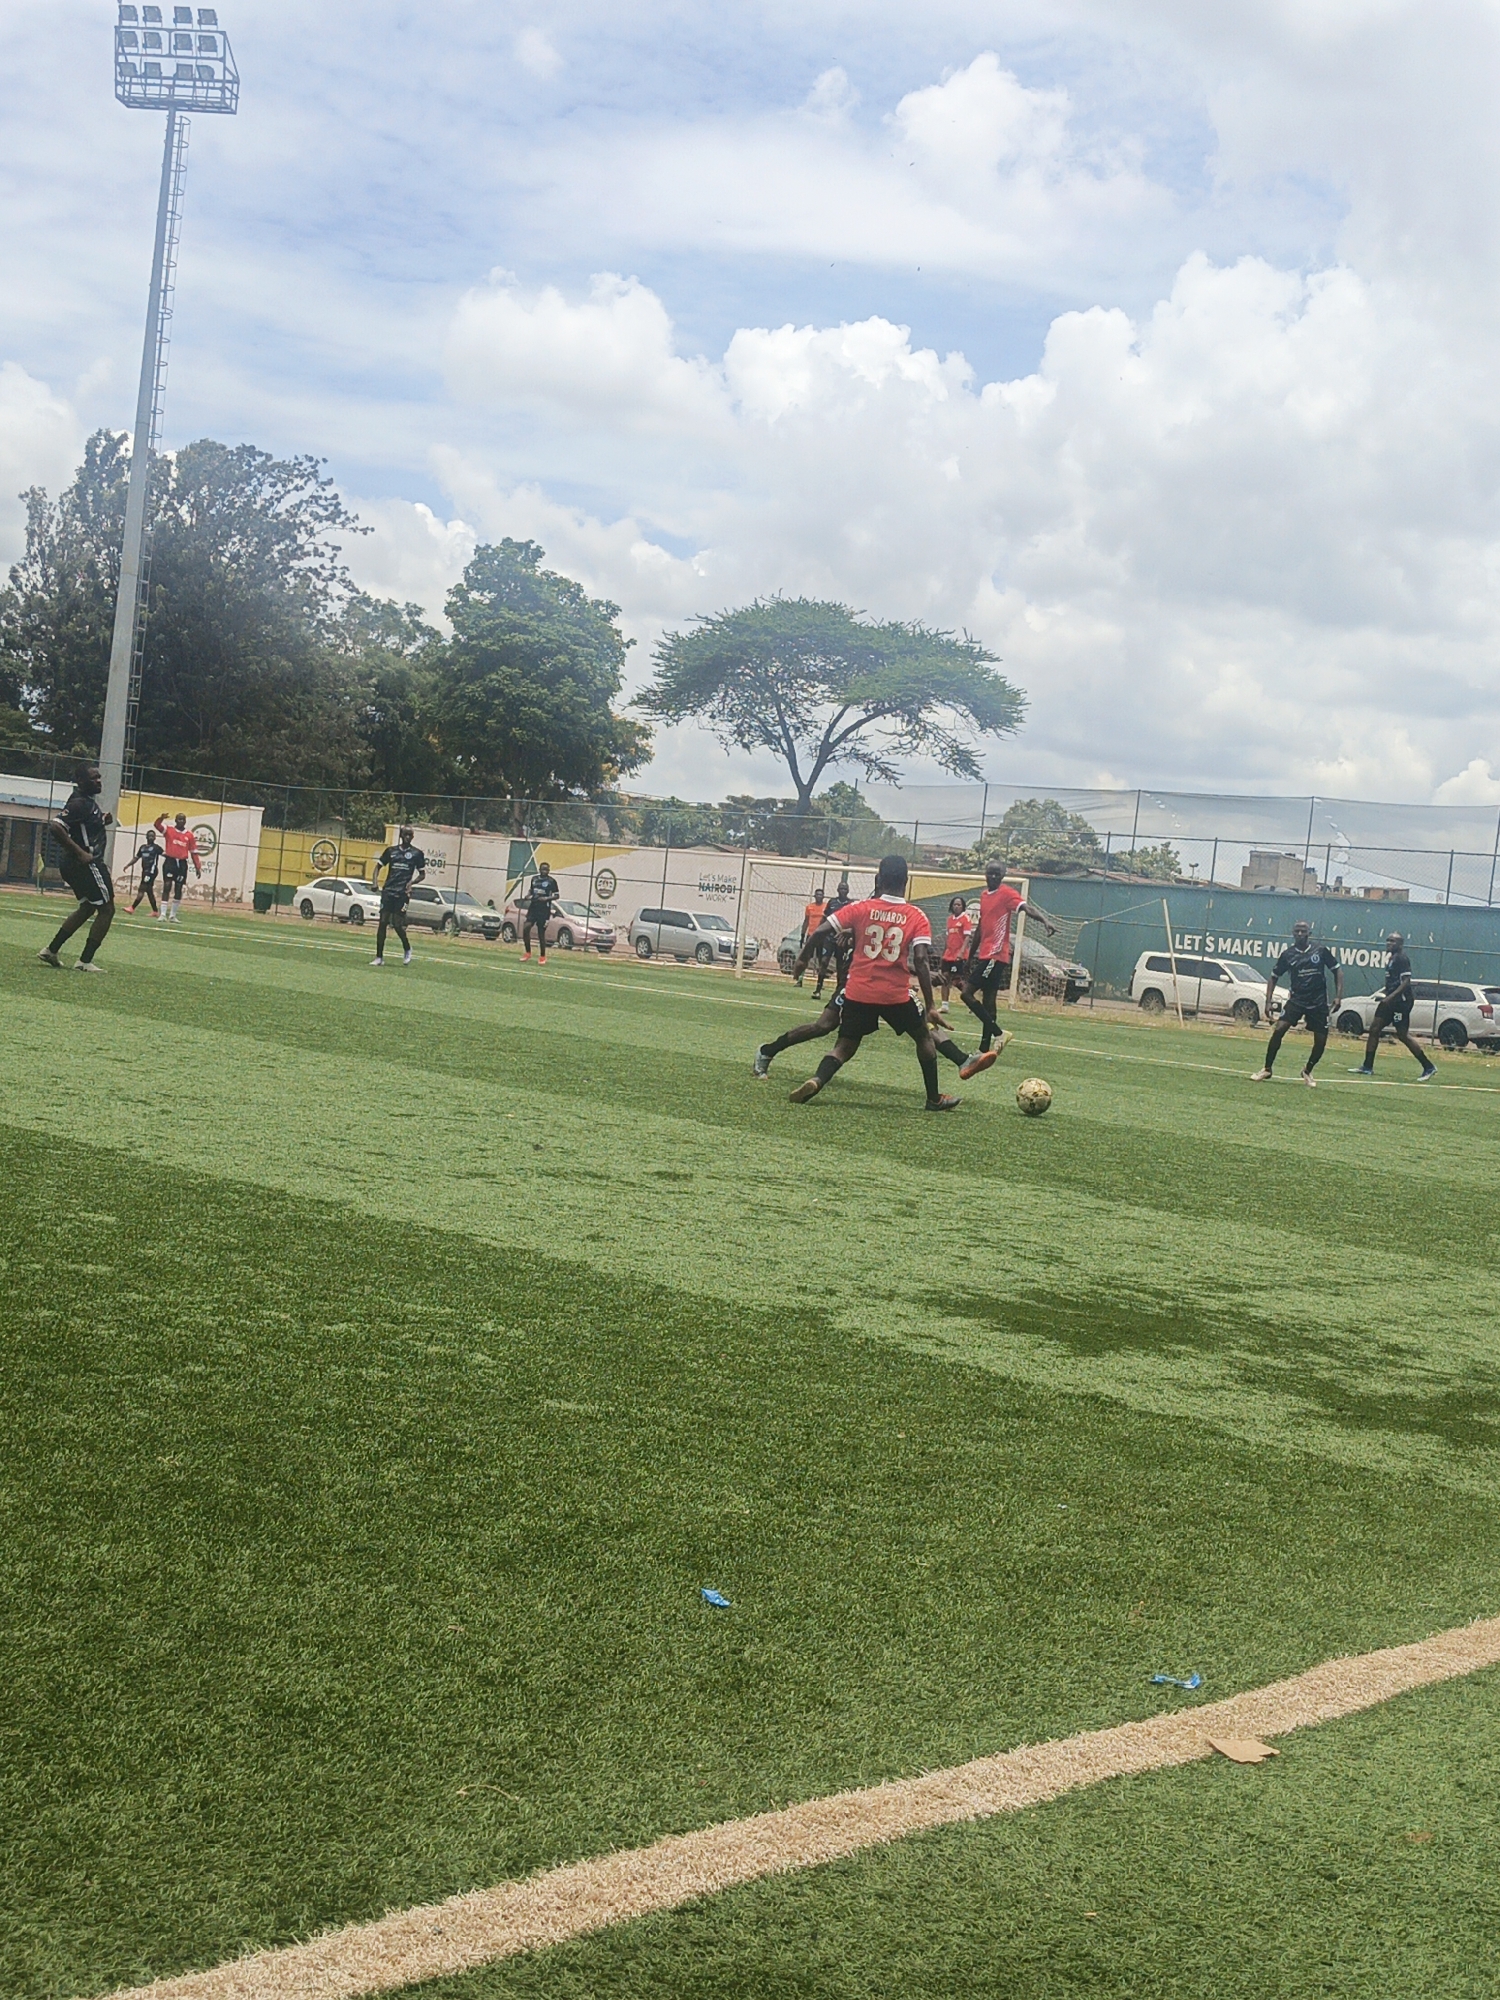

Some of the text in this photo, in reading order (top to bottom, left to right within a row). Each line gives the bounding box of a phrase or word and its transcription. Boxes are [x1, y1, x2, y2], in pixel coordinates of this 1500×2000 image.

[870, 909, 907, 925] EDWARDO
[863, 924, 904, 962] 33
[1175, 932, 1215, 953] LET'S
[1218, 937, 1262, 957] MAKE
[1340, 947, 1393, 968] WORK
